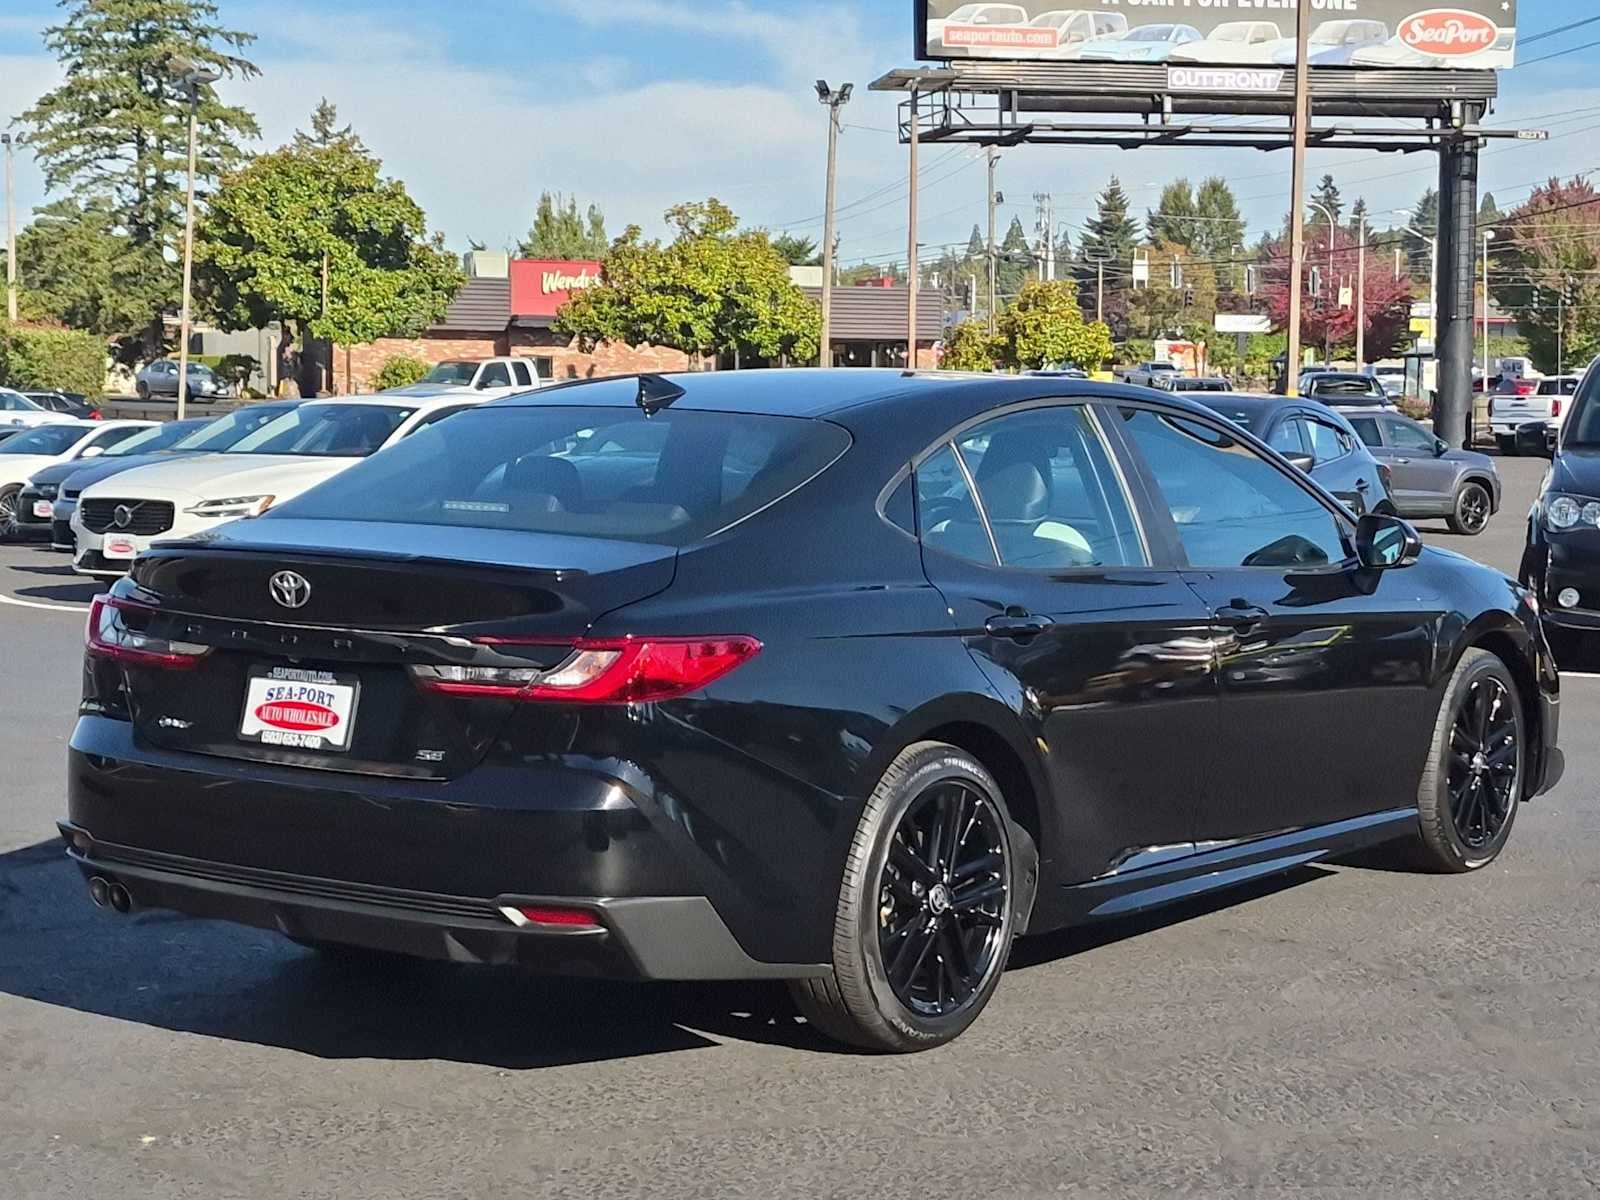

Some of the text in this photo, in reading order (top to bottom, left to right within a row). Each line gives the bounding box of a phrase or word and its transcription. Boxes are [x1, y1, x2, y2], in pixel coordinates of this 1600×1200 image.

[949, 29, 1052, 44] seaportauto.com
[1405, 19, 1491, 45] SeaPort
[1171, 70, 1277, 89] OUTFRONT
[261, 705, 334, 727] AUTO WHOLESALE
